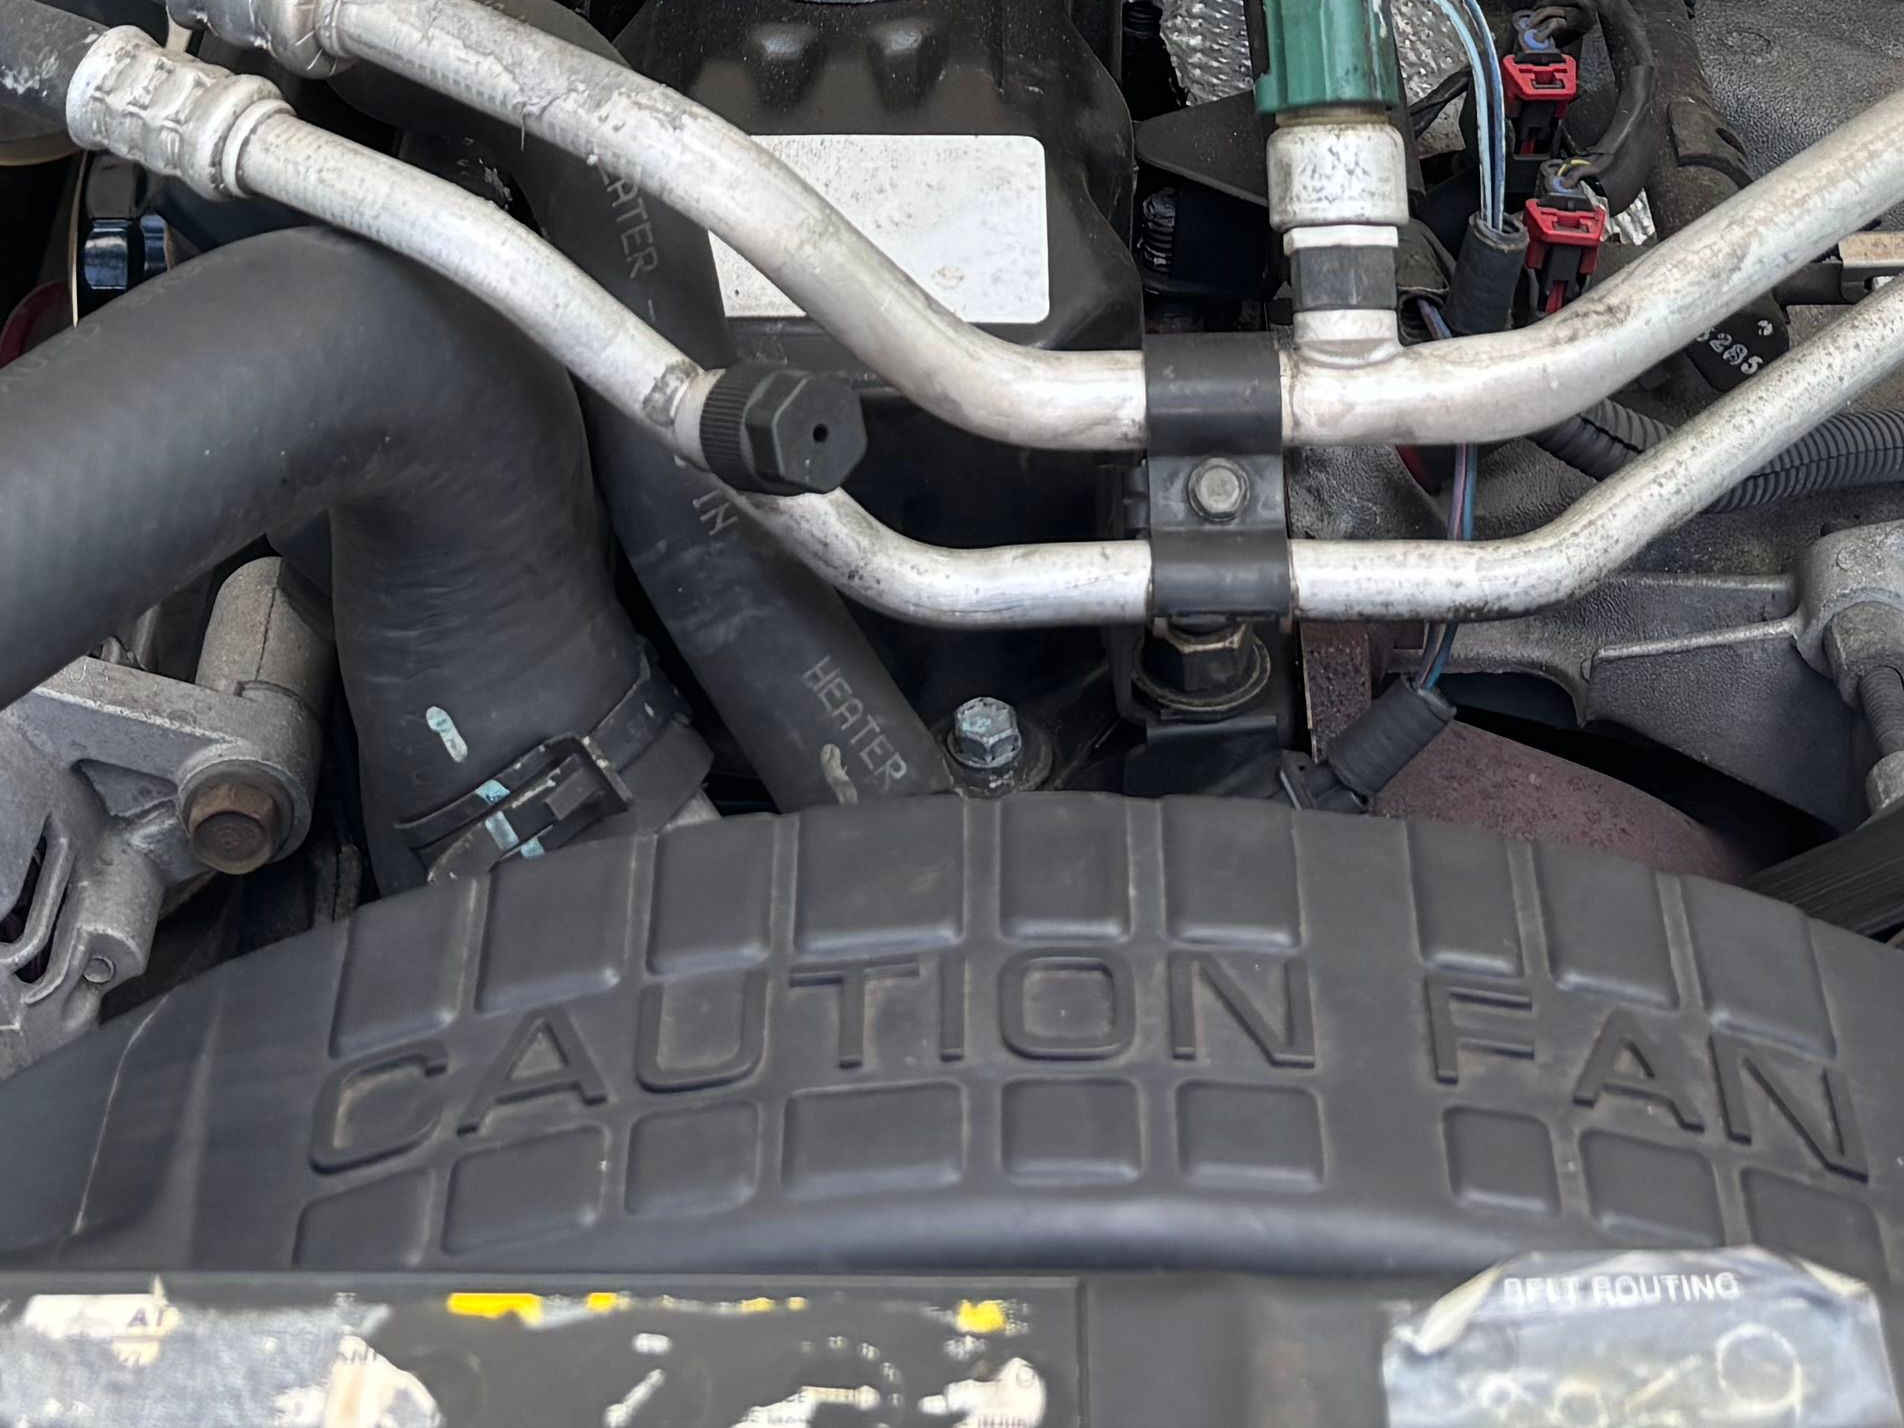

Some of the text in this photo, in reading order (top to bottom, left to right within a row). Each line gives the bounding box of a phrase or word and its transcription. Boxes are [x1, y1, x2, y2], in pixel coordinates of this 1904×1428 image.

[804, 652, 909, 798] HEATER
[309, 945, 1871, 1184] CAUTION FAN
